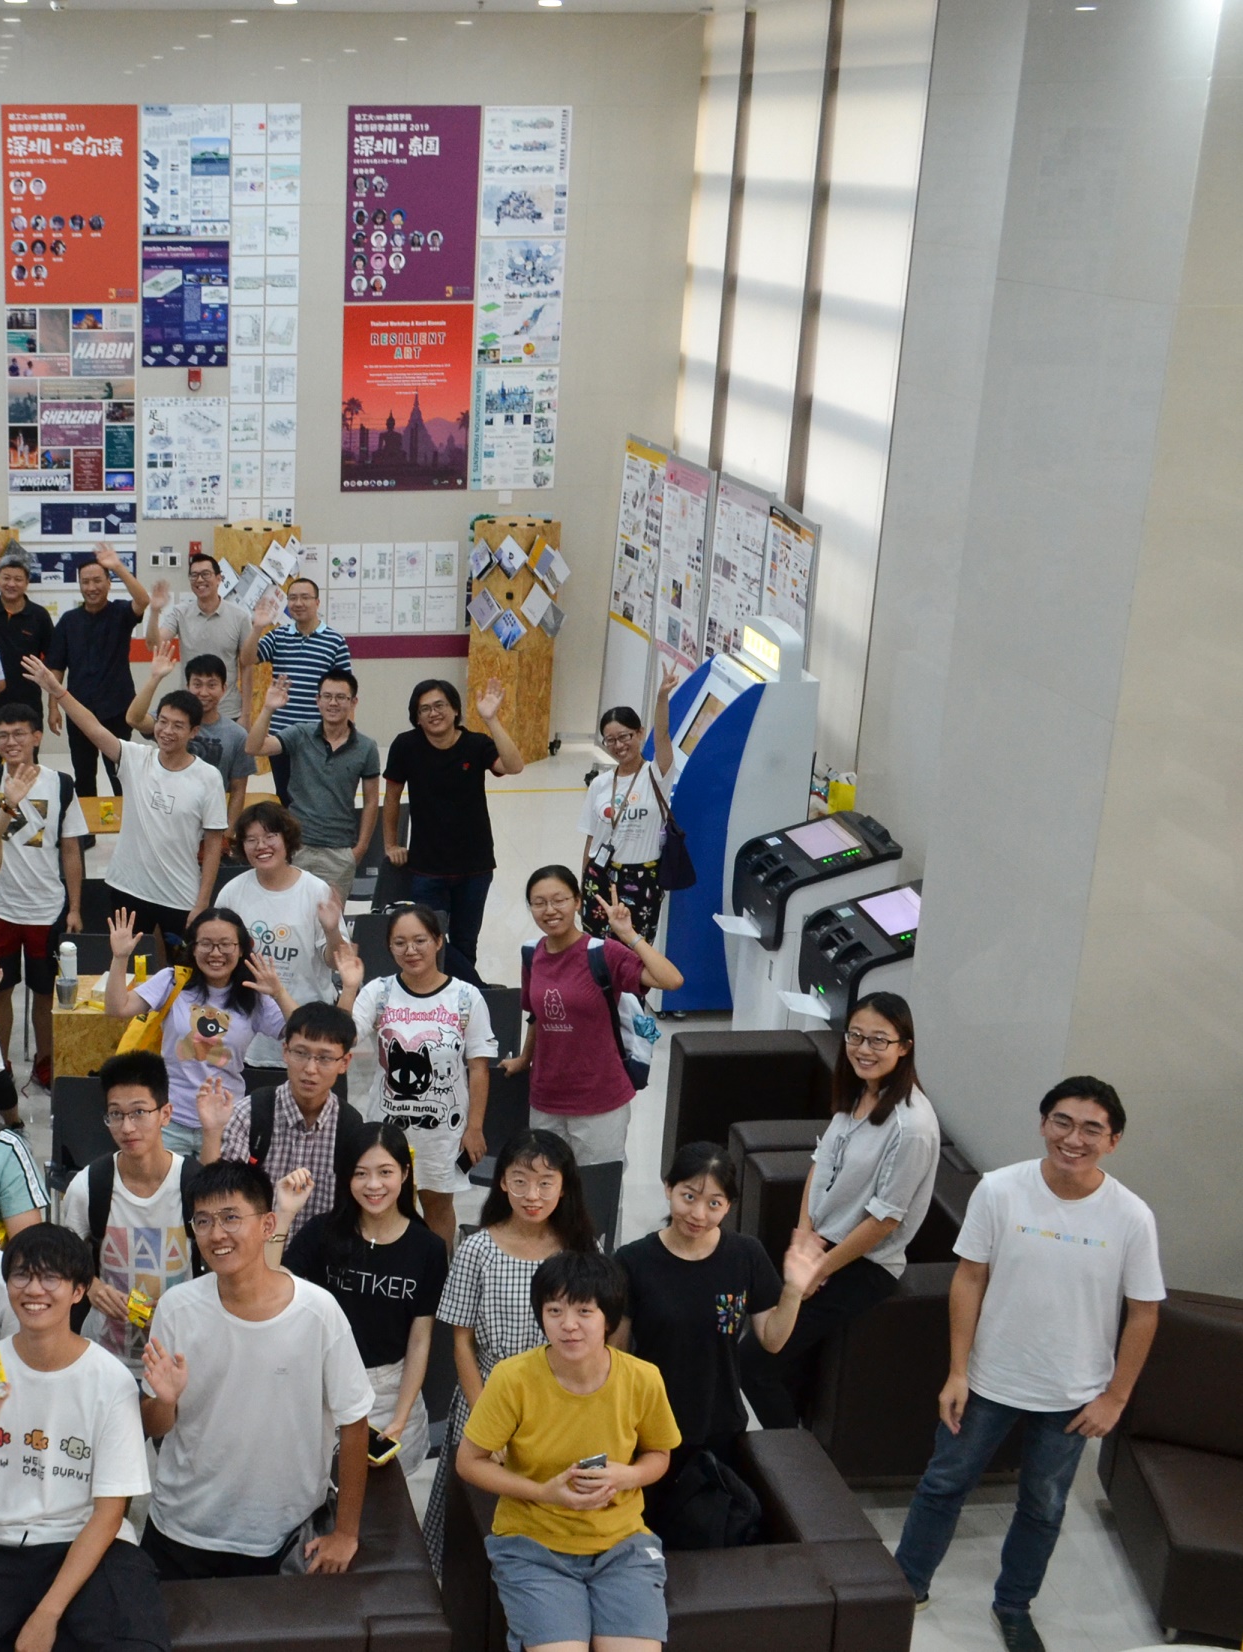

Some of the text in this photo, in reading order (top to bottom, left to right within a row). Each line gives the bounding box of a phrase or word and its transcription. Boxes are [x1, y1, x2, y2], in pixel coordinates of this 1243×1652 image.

[65, 123, 86, 131] 2019
[410, 123, 430, 131] 2019
[370, 332, 446, 346] RESILIENT
[74, 342, 133, 359] HARBIN
[394, 346, 422, 360] ART
[40, 410, 103, 425] SHENZHEN
[12, 475, 69, 487] HONGKONG
[261, 945, 299, 961] AUP
[52, 1466, 91, 1483] BURNT
